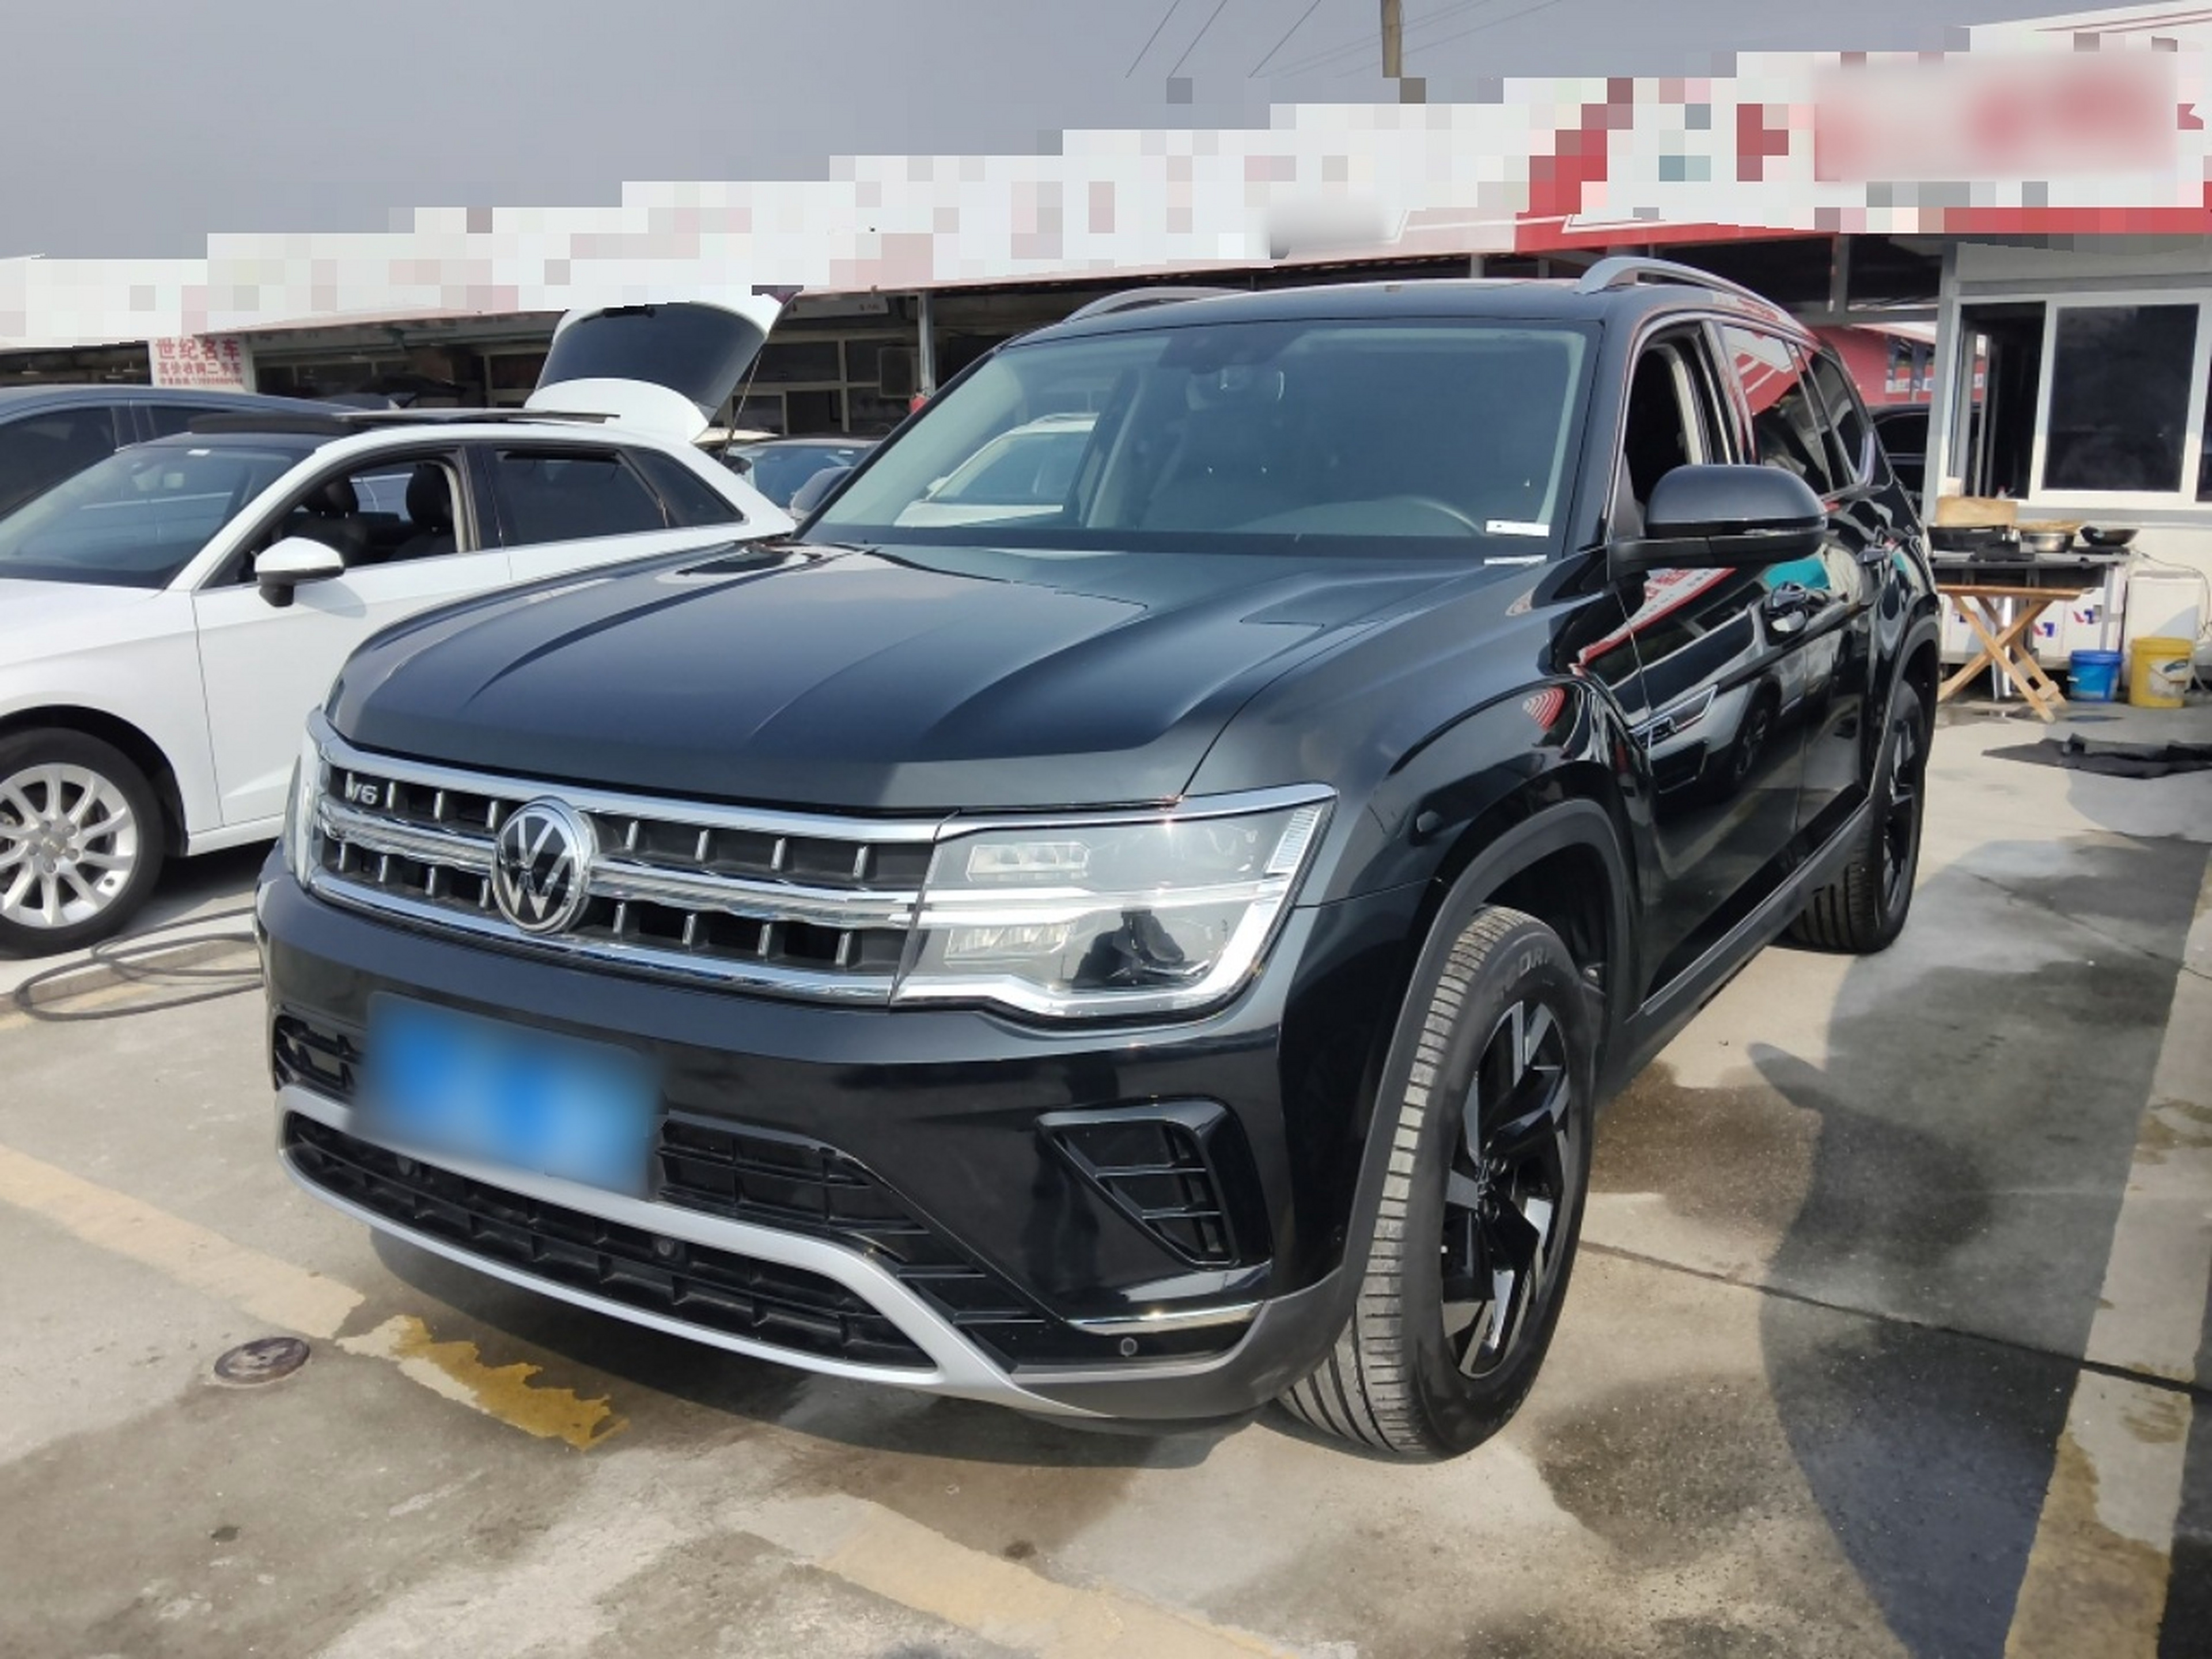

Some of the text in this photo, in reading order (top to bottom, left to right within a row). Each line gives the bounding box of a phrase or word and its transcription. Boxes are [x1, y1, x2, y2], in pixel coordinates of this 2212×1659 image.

[156, 337, 241, 361] 世纪名车
[347, 782, 378, 805] V6
